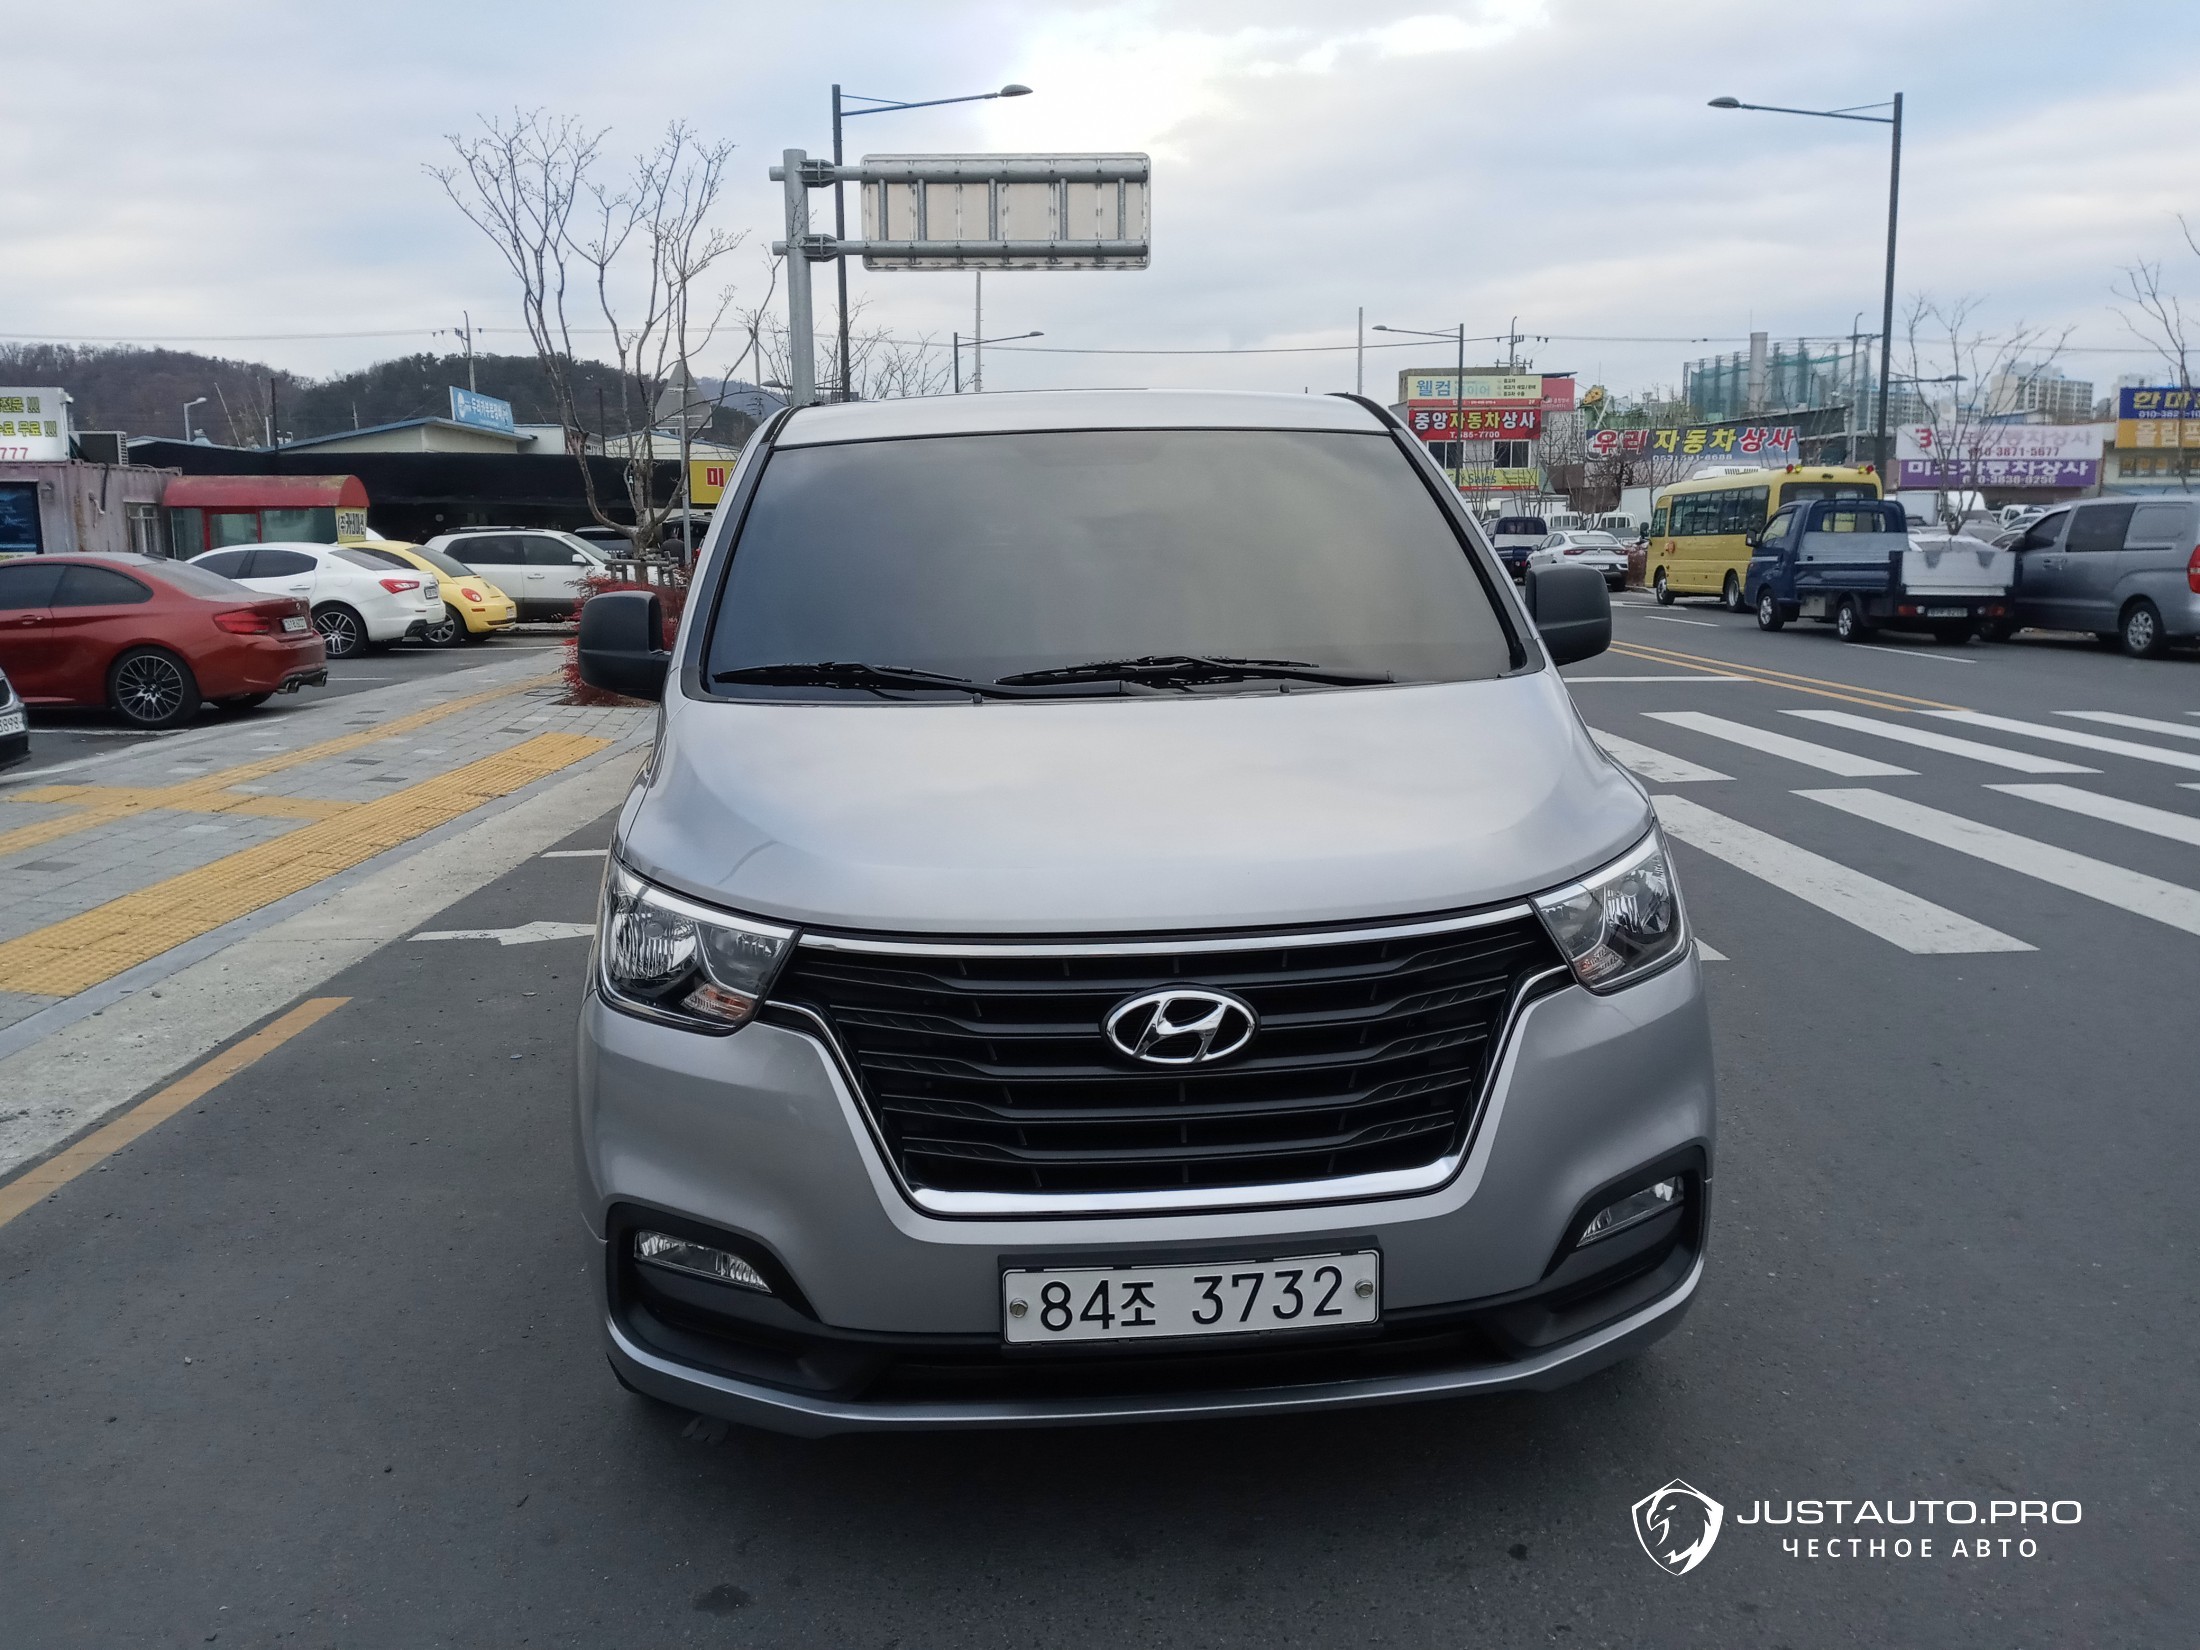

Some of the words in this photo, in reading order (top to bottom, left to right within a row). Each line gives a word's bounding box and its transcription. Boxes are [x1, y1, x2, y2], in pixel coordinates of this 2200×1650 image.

[1416, 380, 1451, 397] 웰컴
[0, 396, 24, 413] 전문
[1039, 1279, 1157, 1332] 84조
[1191, 1265, 1343, 1325] 3732
